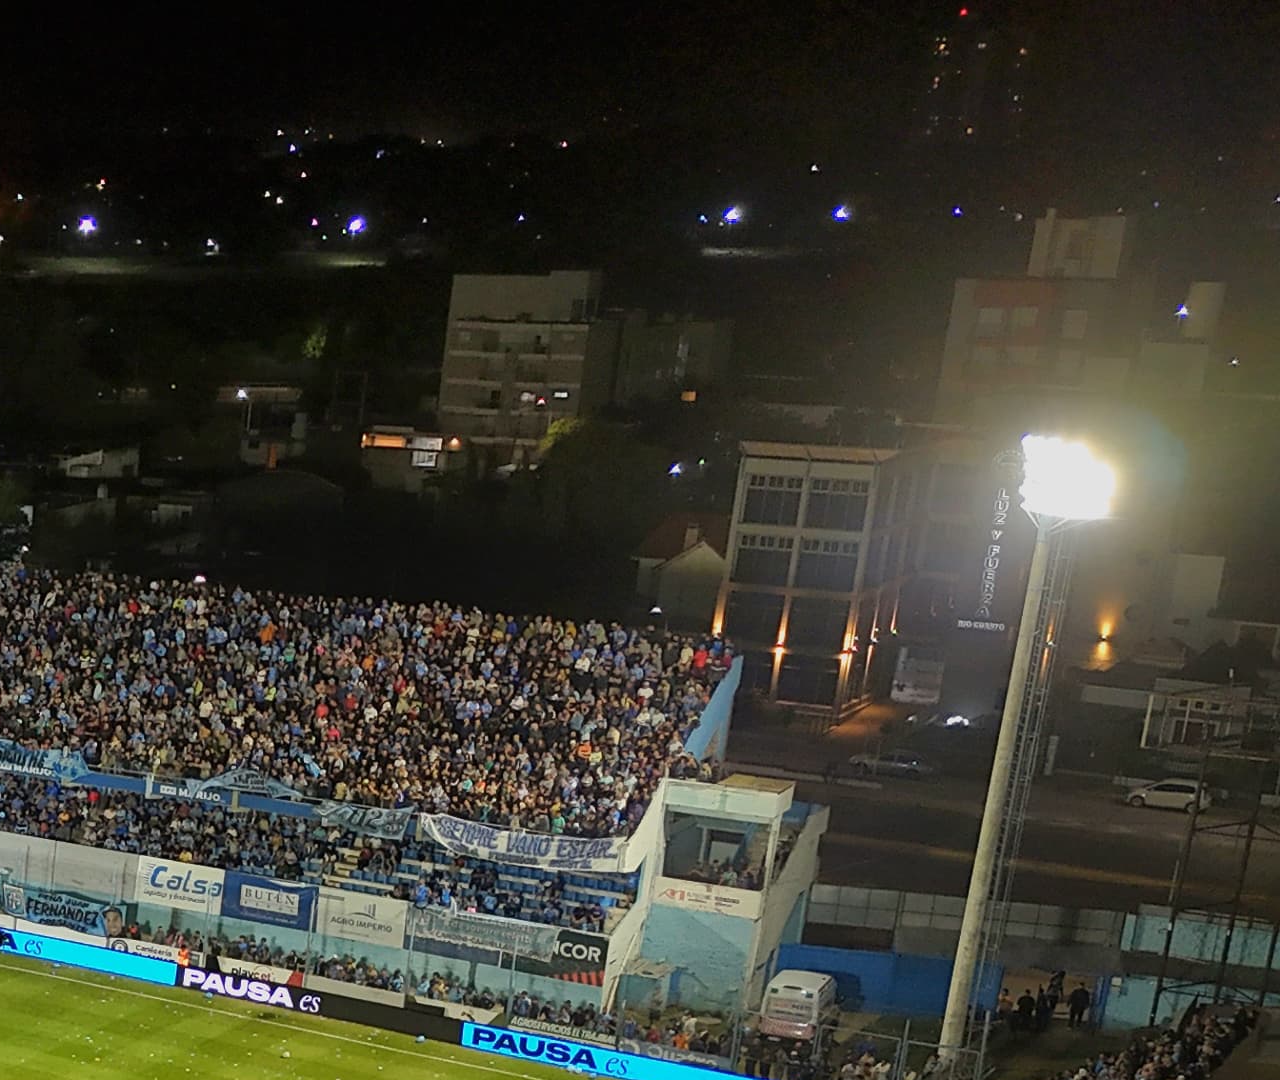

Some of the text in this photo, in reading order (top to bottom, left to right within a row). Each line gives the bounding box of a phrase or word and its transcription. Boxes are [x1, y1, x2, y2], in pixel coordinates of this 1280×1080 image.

[993, 487, 1010, 525] LUZ
[974, 545, 1001, 619] FUERZA
[149, 865, 223, 897] Calsa
[331, 916, 393, 934] AGRO IMPERIO
[24, 939, 43, 954] es
[182, 966, 321, 1014] PAUSA es
[510, 1016, 572, 1036] AGROSERVICIOS
[472, 1027, 597, 1070] PAUSA
[605, 1056, 630, 1076] es
